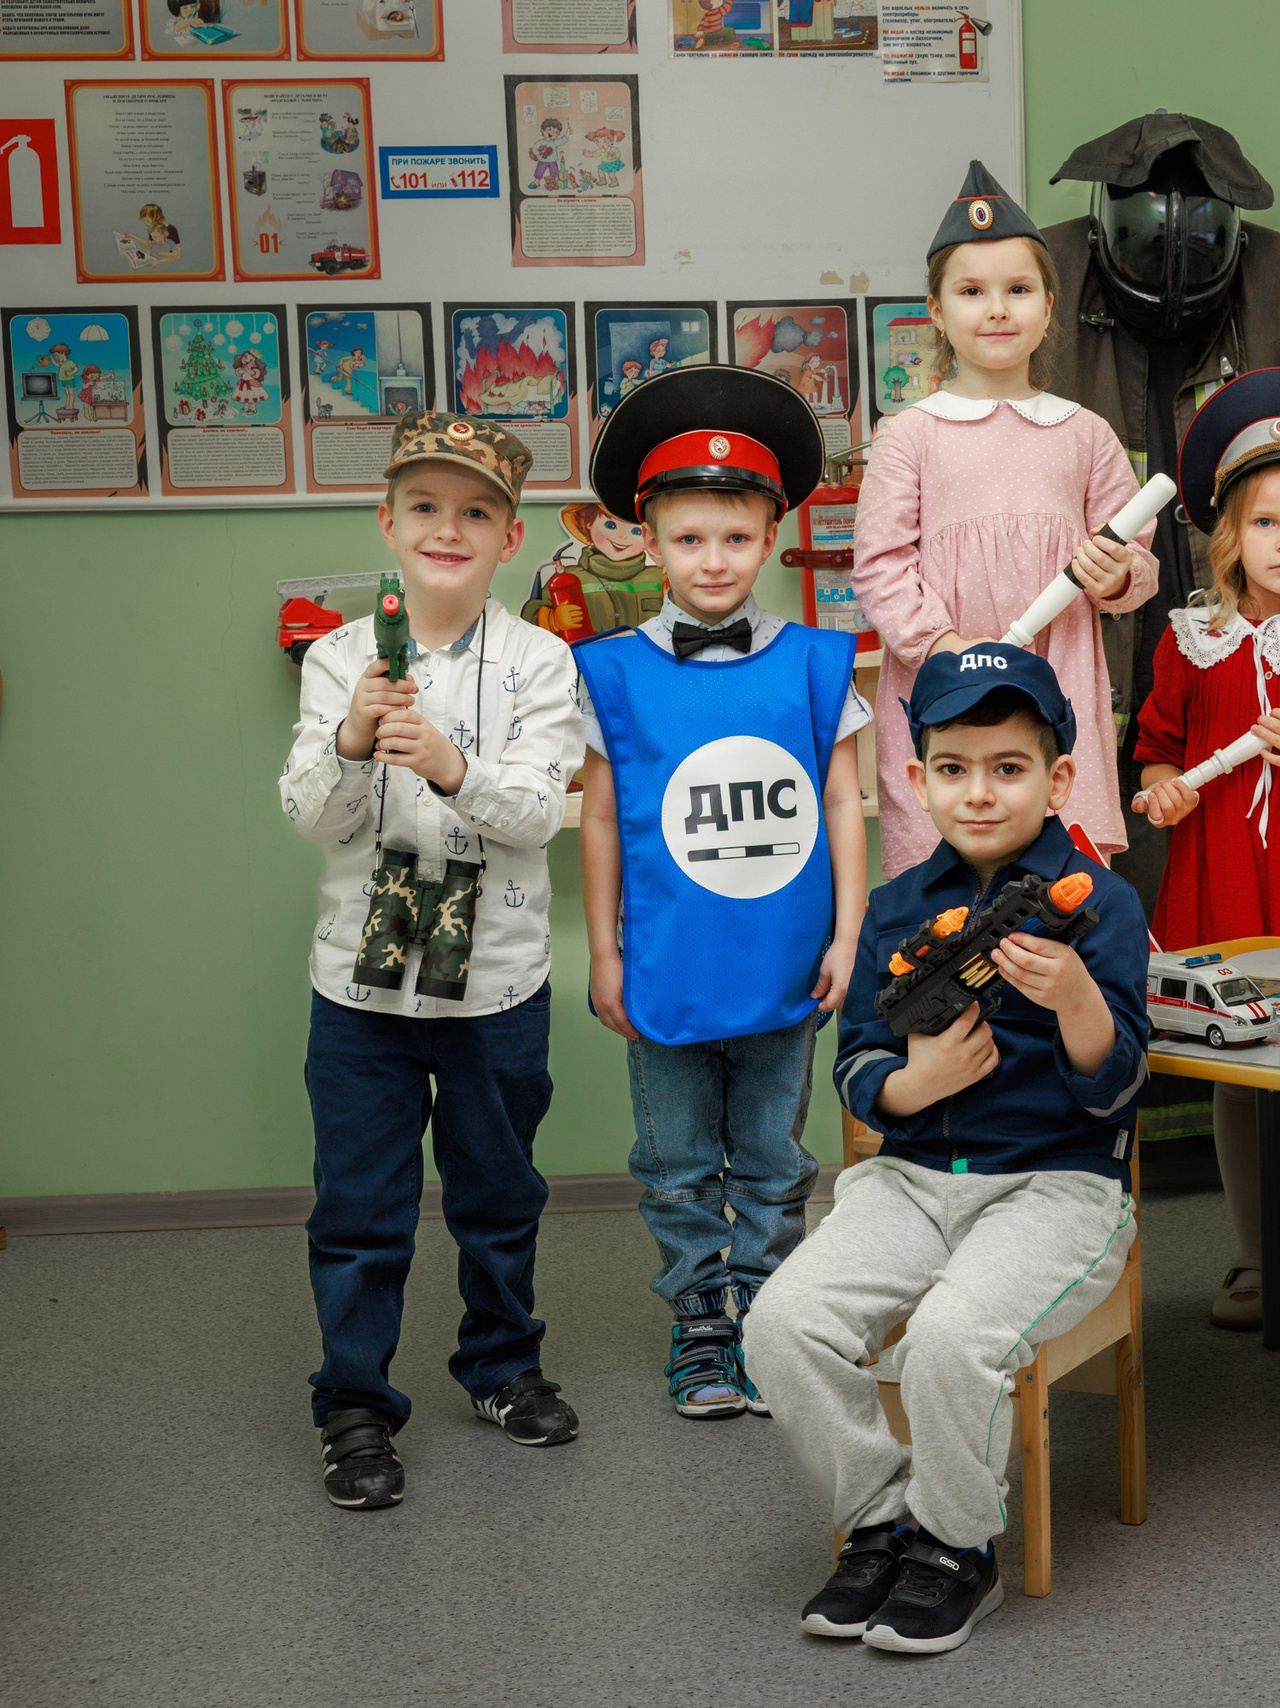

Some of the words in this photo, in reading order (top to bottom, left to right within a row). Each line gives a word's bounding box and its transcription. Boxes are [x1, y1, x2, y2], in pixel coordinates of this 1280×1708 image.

[392, 158, 408, 166] ПРИ
[410, 158, 446, 166] ПОЖАРЕ
[448, 157, 486, 165] ЗВОНИТЬ
[399, 172, 428, 188] 101
[457, 170, 490, 188] 112
[259, 232, 279, 254] 01
[960, 653, 1008, 673] ДПС
[684, 778, 798, 835] ДПС
[1217, 968, 1233, 976] 03
[938, 1556, 960, 1572] GSD
